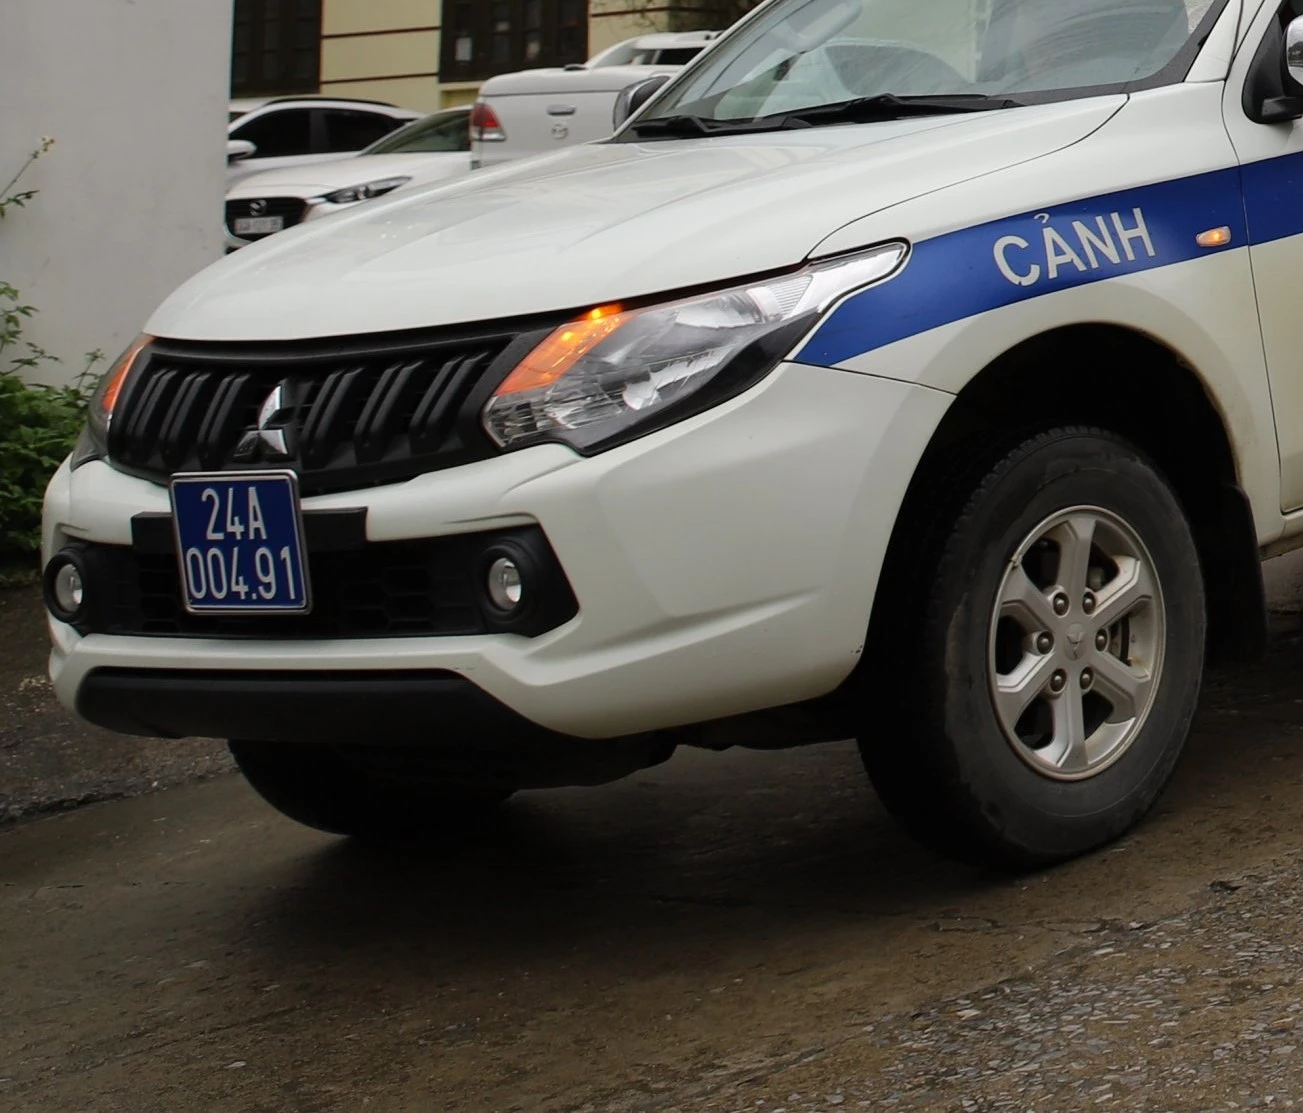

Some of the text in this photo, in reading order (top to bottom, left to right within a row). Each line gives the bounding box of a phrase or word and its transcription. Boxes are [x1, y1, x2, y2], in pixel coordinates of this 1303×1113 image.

[993, 208, 1156, 287] CẢNH
[201, 486, 268, 540] 24A
[185, 545, 296, 600] 004.91
